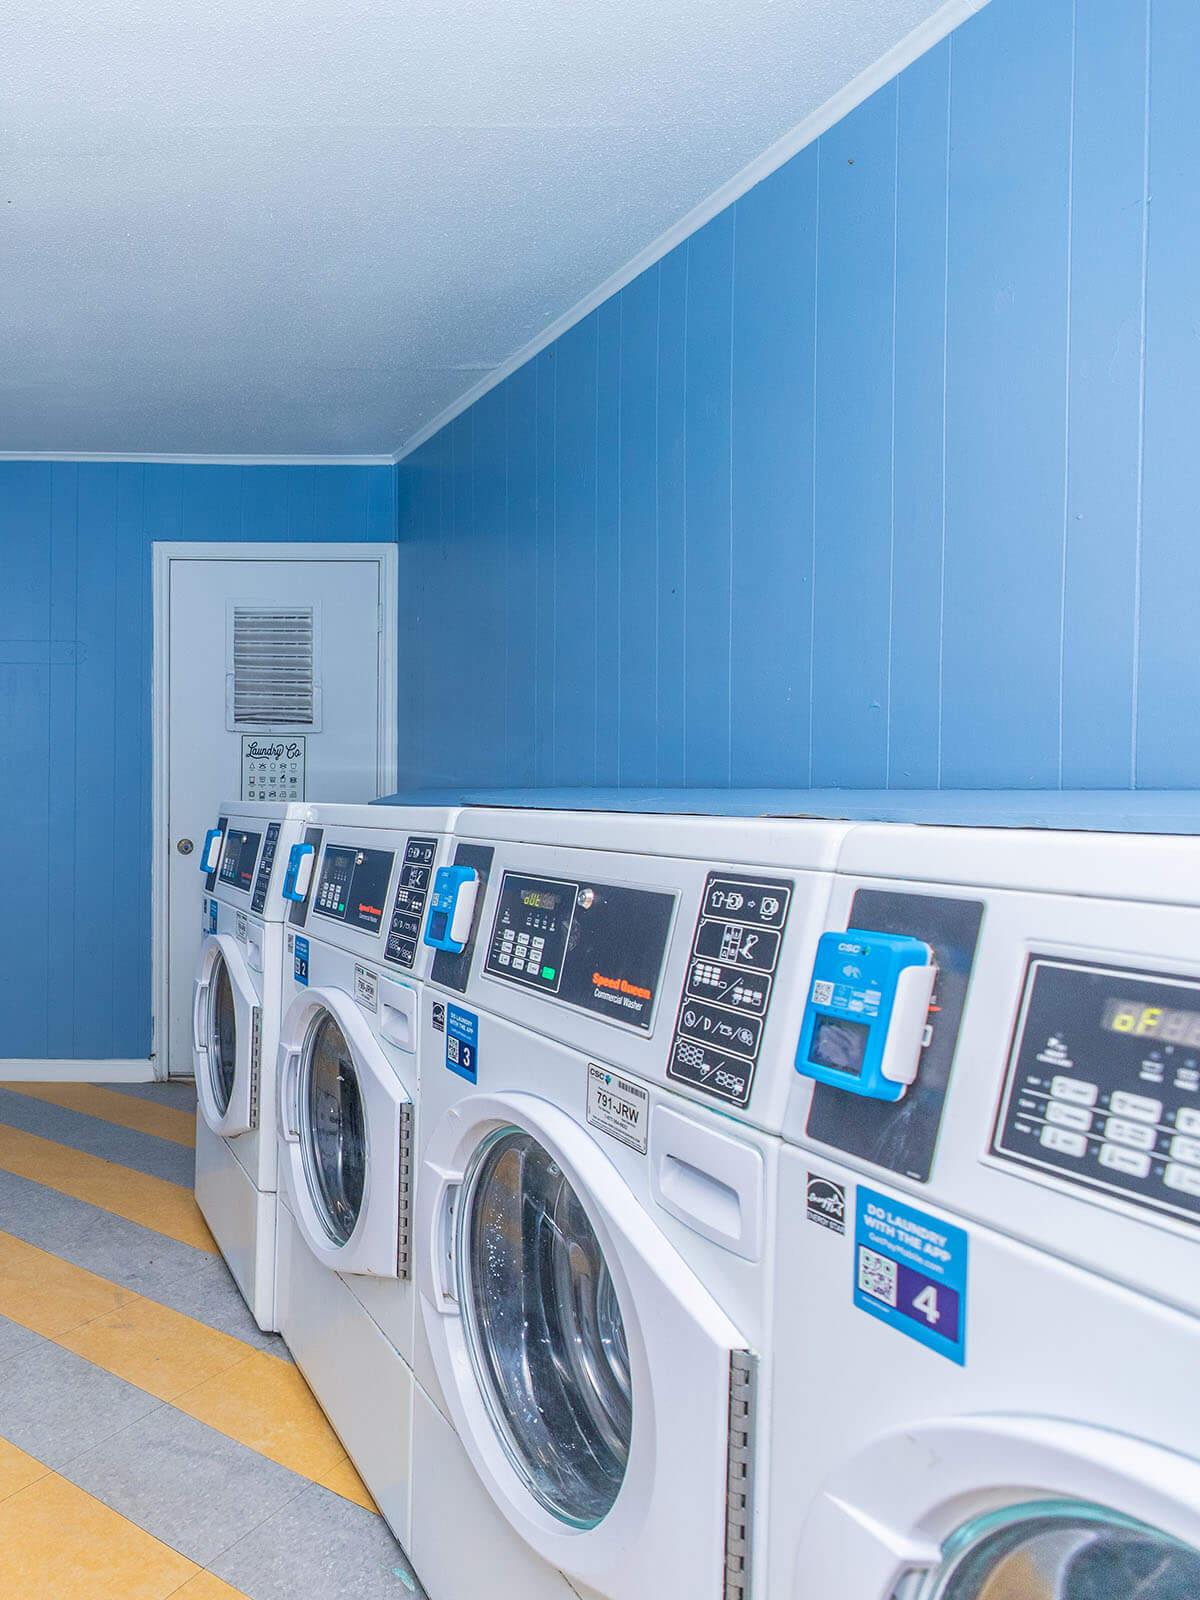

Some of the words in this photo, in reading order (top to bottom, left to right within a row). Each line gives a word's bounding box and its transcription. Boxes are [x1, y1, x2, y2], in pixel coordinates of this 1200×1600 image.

[246, 741, 285, 760] Laundry
[286, 742, 302, 760] Co
[838, 943, 862, 954] CSC
[301, 962, 306, 976] 2
[592, 972, 620, 990] Speed
[620, 980, 652, 1000] Queen
[594, 988, 622, 1005] Commercial
[623, 996, 644, 1011] Washer
[463, 1047, 470, 1067] 3
[590, 1068, 604, 1080] CSC
[596, 1092, 640, 1124] 791-JRW
[866, 1203, 884, 1219] DO
[886, 1211, 948, 1248] LAUNDRY
[863, 1215, 896, 1238] WITH
[898, 1228, 923, 1250] THE
[924, 1239, 952, 1262] APP
[868, 1232, 945, 1274] GetPayMobile.com
[912, 1285, 941, 1324] 4
